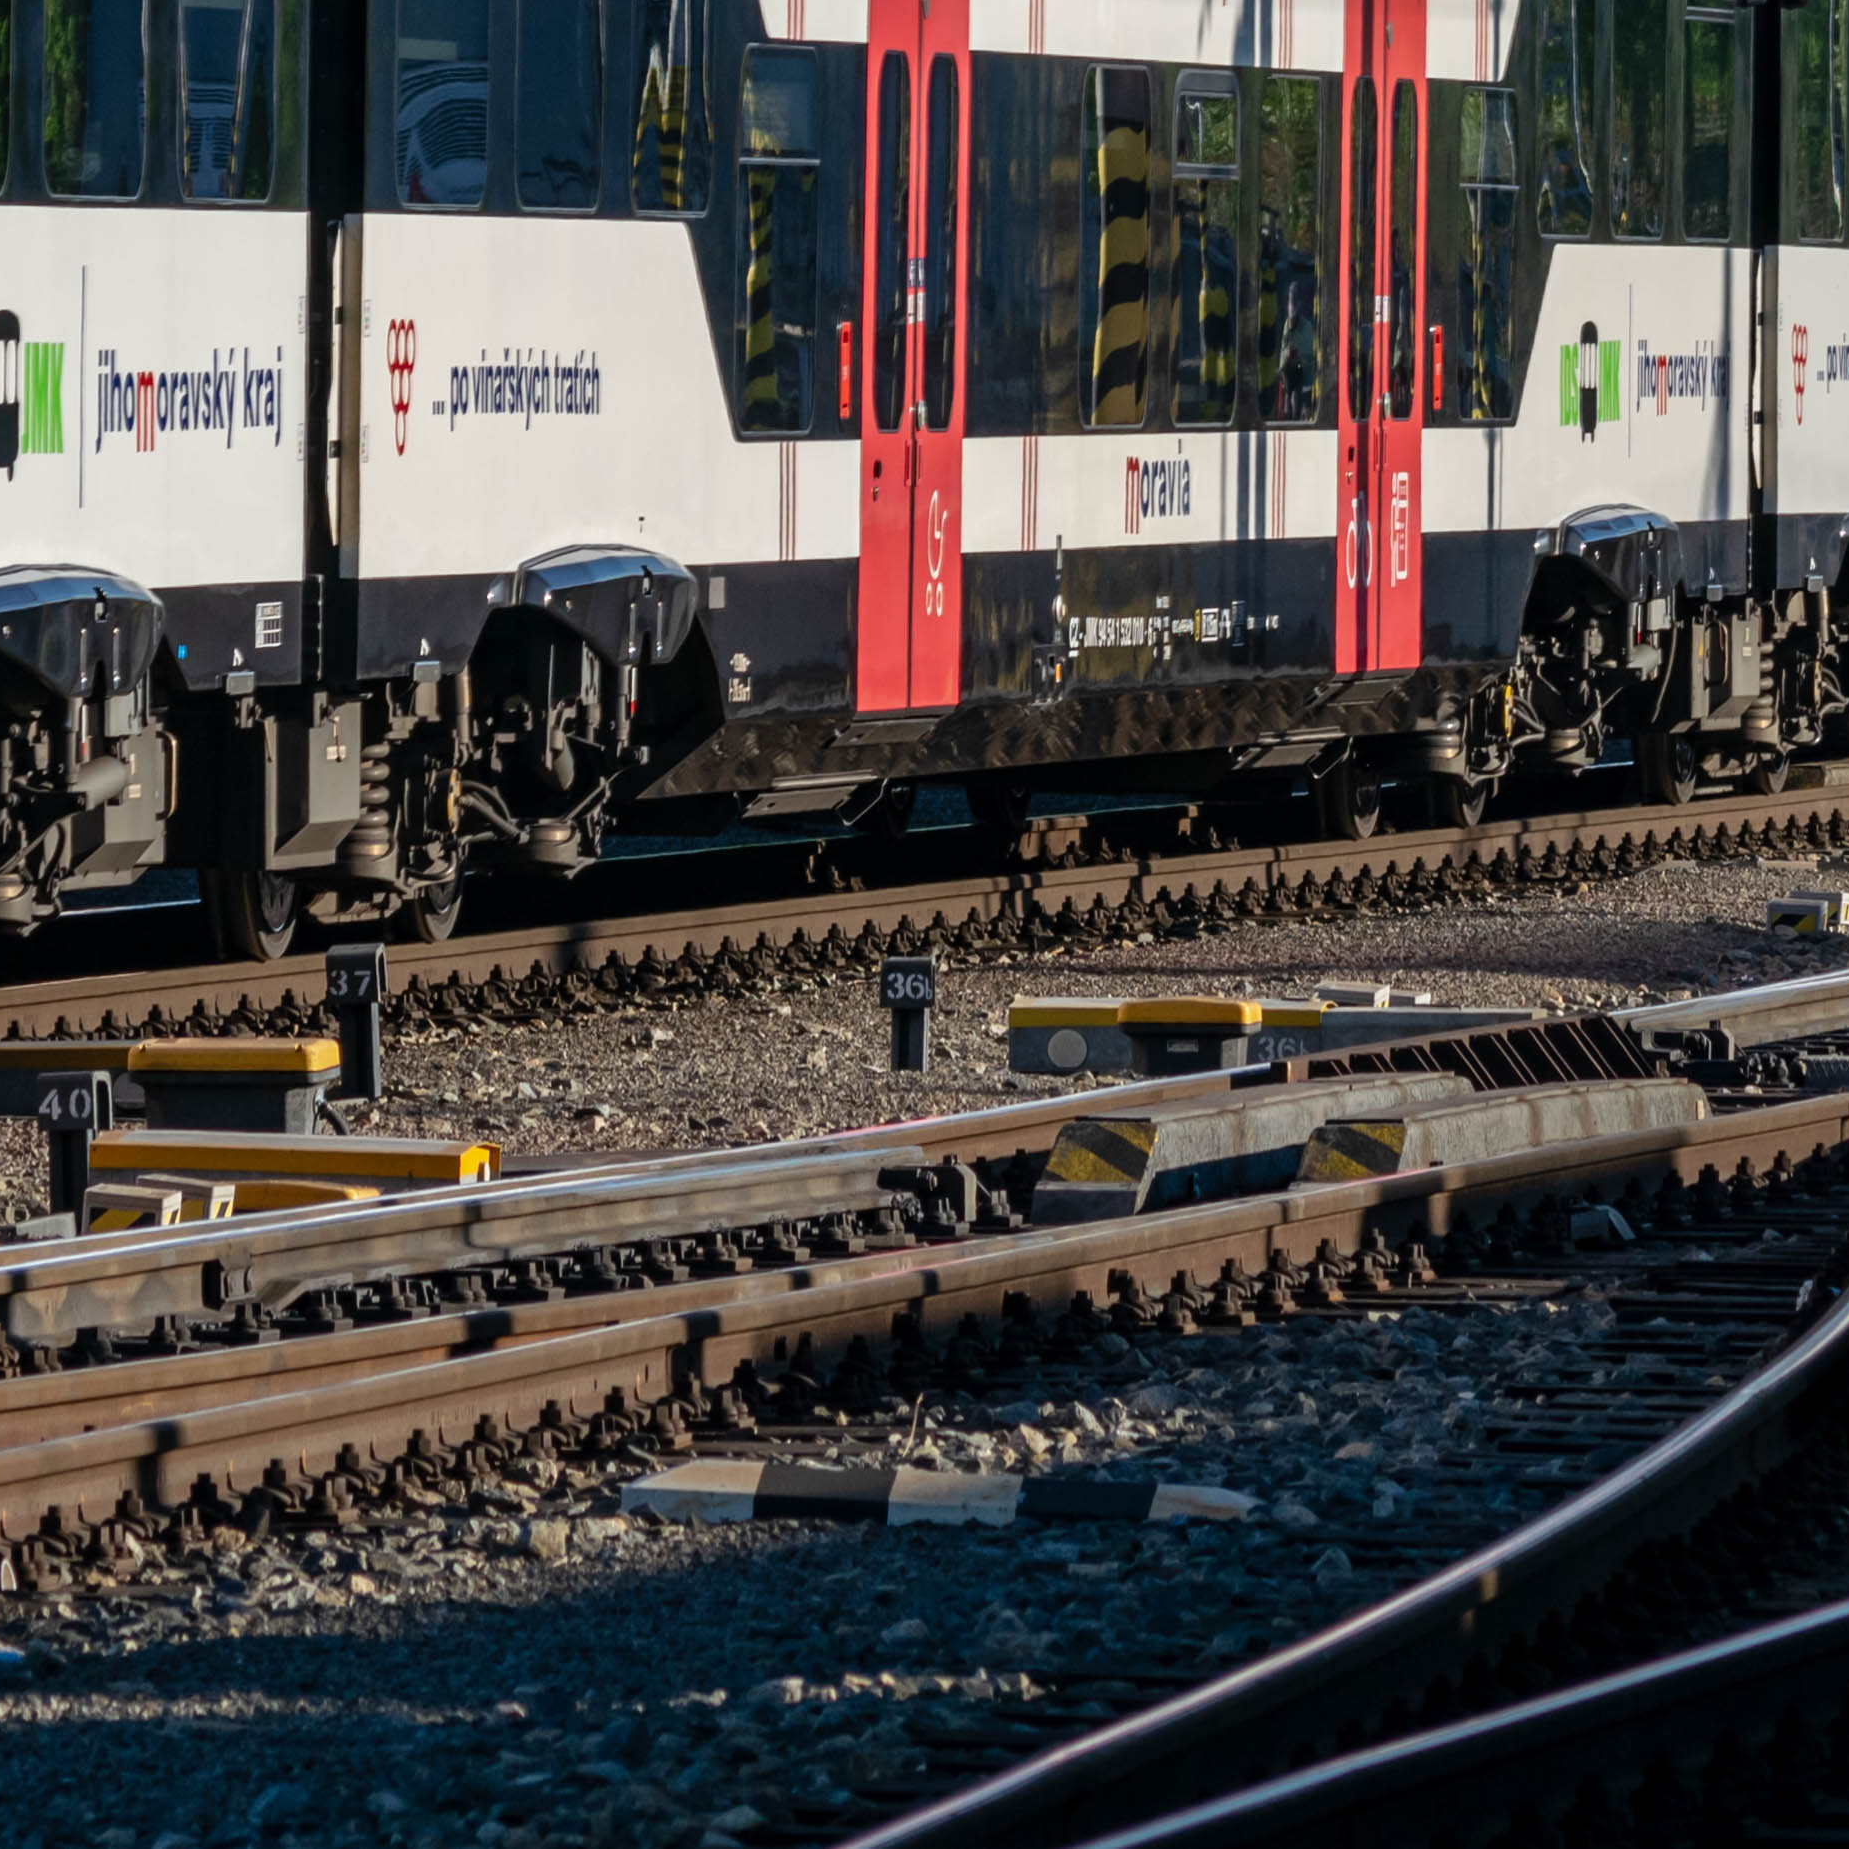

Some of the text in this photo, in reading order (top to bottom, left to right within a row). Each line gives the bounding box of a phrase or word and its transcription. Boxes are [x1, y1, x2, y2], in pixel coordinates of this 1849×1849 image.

[22, 342, 66, 455] JMK
[95, 345, 283, 456] jihomoravský kraj
[450, 365, 469, 432] po
[1125, 438, 1191, 535] moravia
[330, 969, 371, 997] 37
[887, 972, 933, 1000] 36b
[38, 1087, 92, 1121] 40
